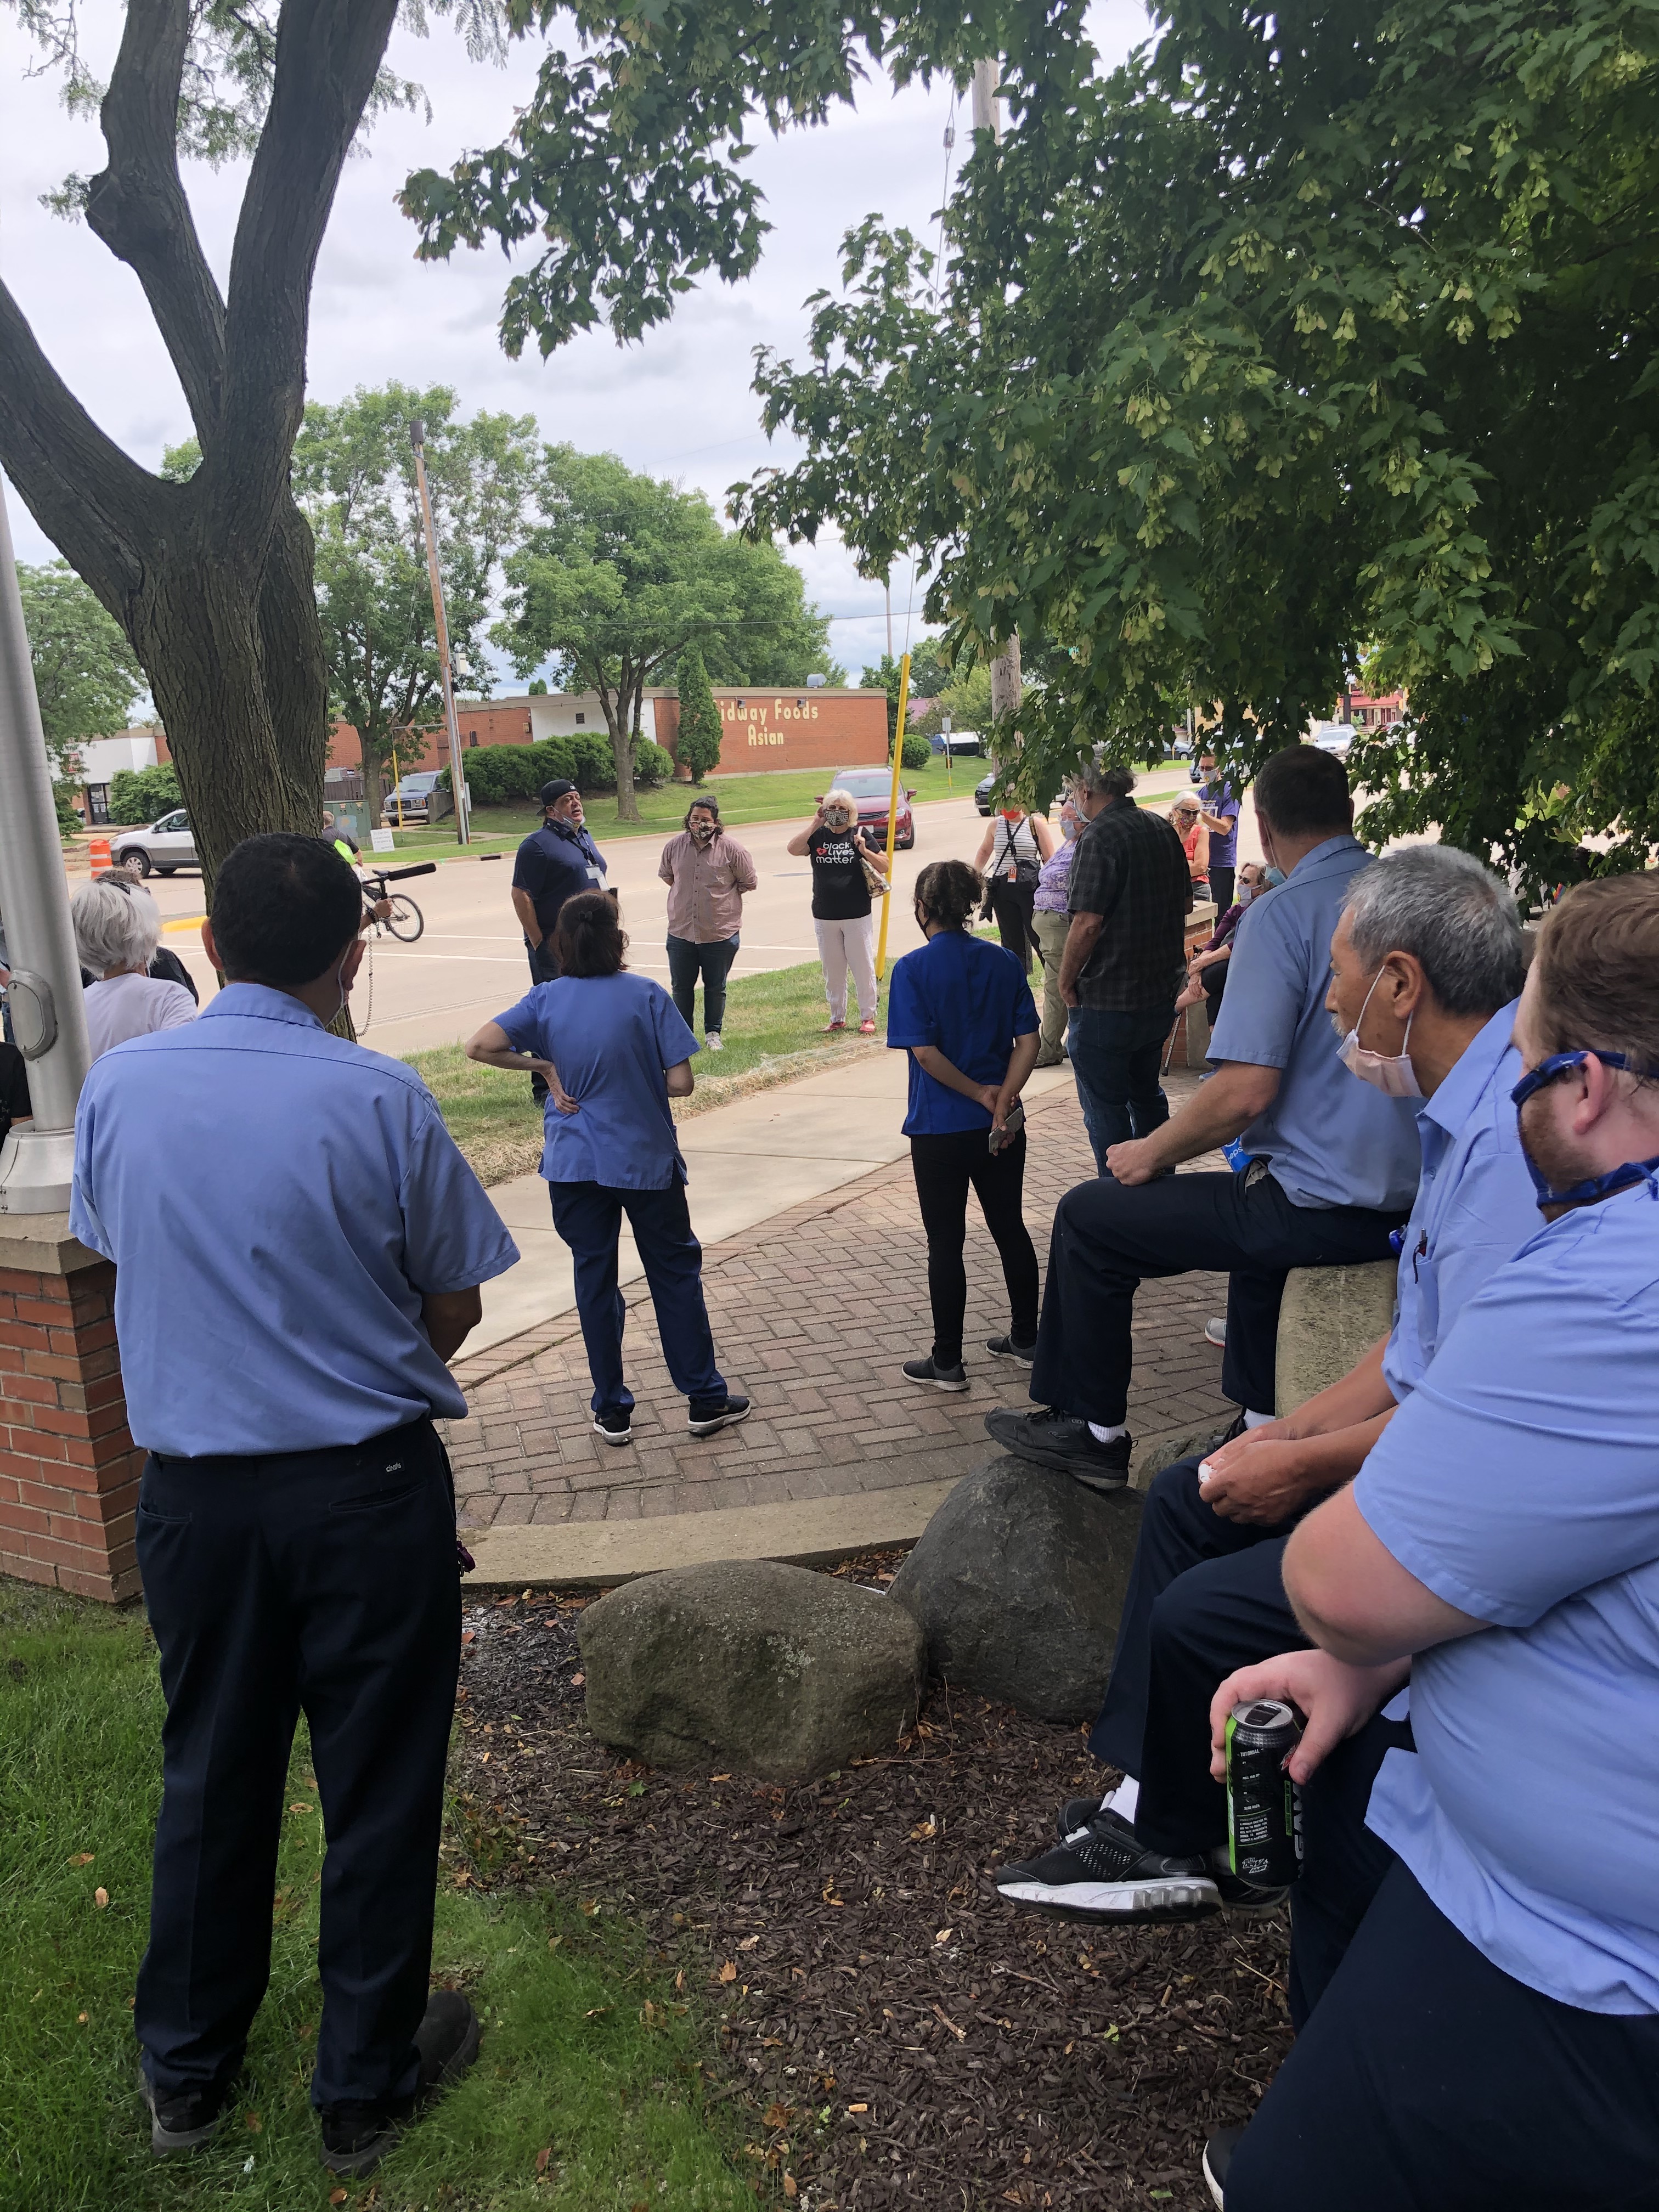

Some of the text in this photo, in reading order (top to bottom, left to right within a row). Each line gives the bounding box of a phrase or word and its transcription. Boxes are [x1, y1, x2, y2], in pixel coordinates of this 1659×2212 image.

[713, 698, 819, 725] idway Foods
[747, 724, 784, 747] Asian
[823, 842, 850, 850] black
[816, 855, 854, 864] matter
[1228, 1147, 1243, 1163] peps
